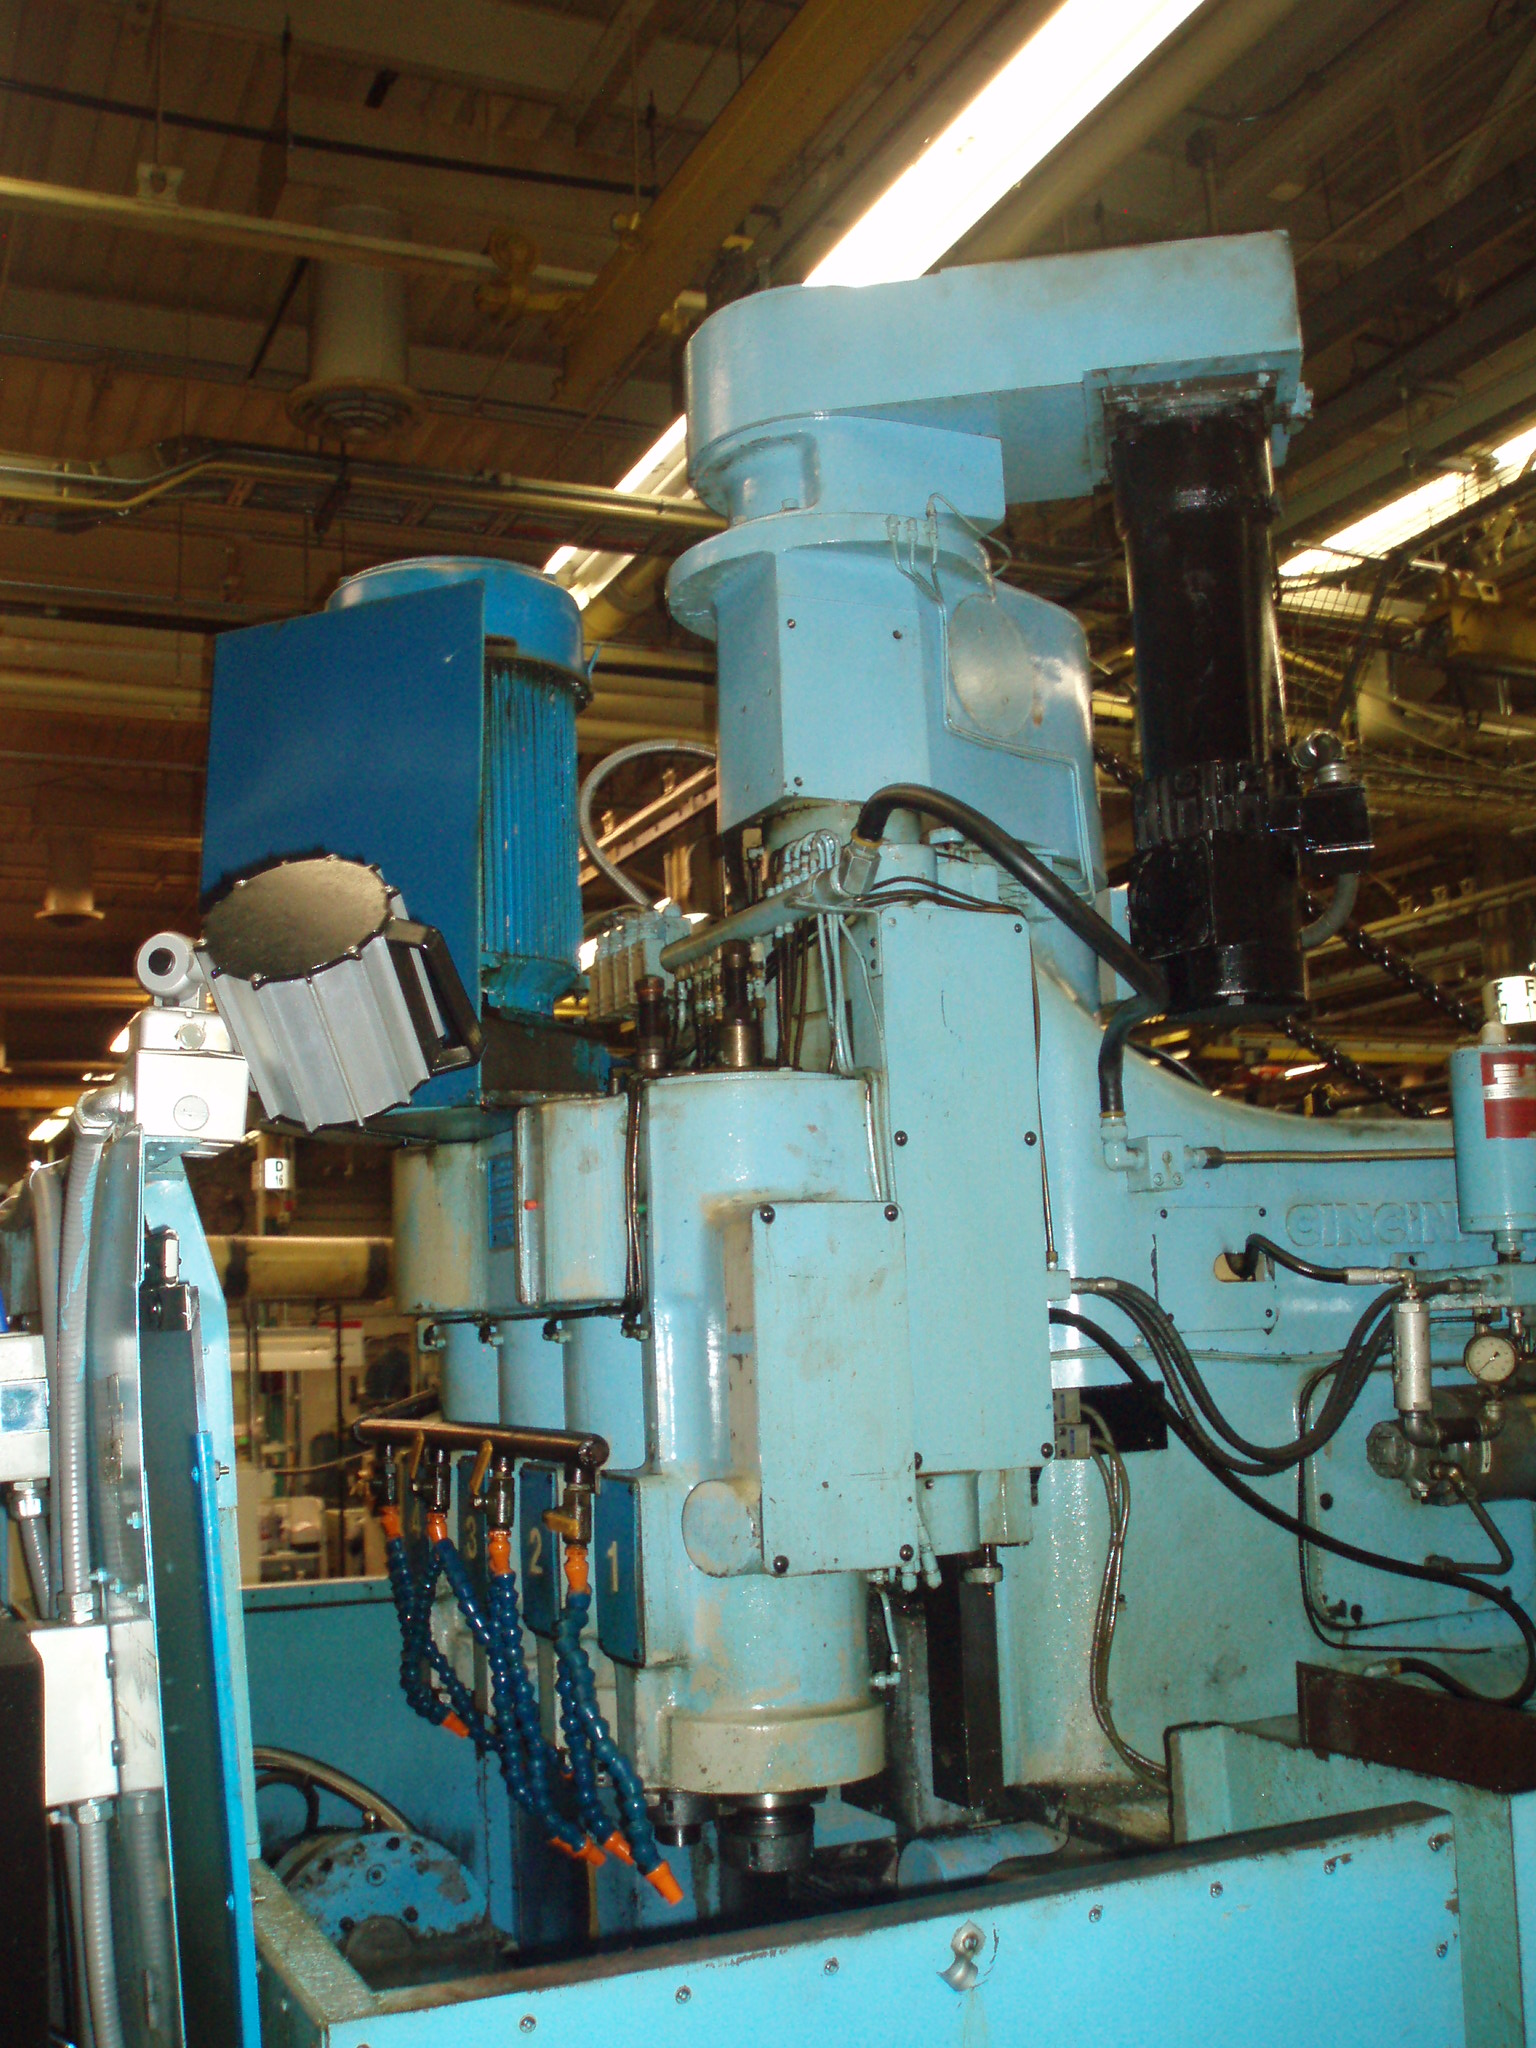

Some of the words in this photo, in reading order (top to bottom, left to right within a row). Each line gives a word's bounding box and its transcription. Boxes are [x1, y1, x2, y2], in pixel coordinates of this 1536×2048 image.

[275, 1160, 284, 1172] D
[1285, 1201, 1468, 1247] CINCIN
[465, 1515, 478, 1559] 3
[529, 1527, 543, 1575] 2
[607, 1541, 619, 1592] 1
